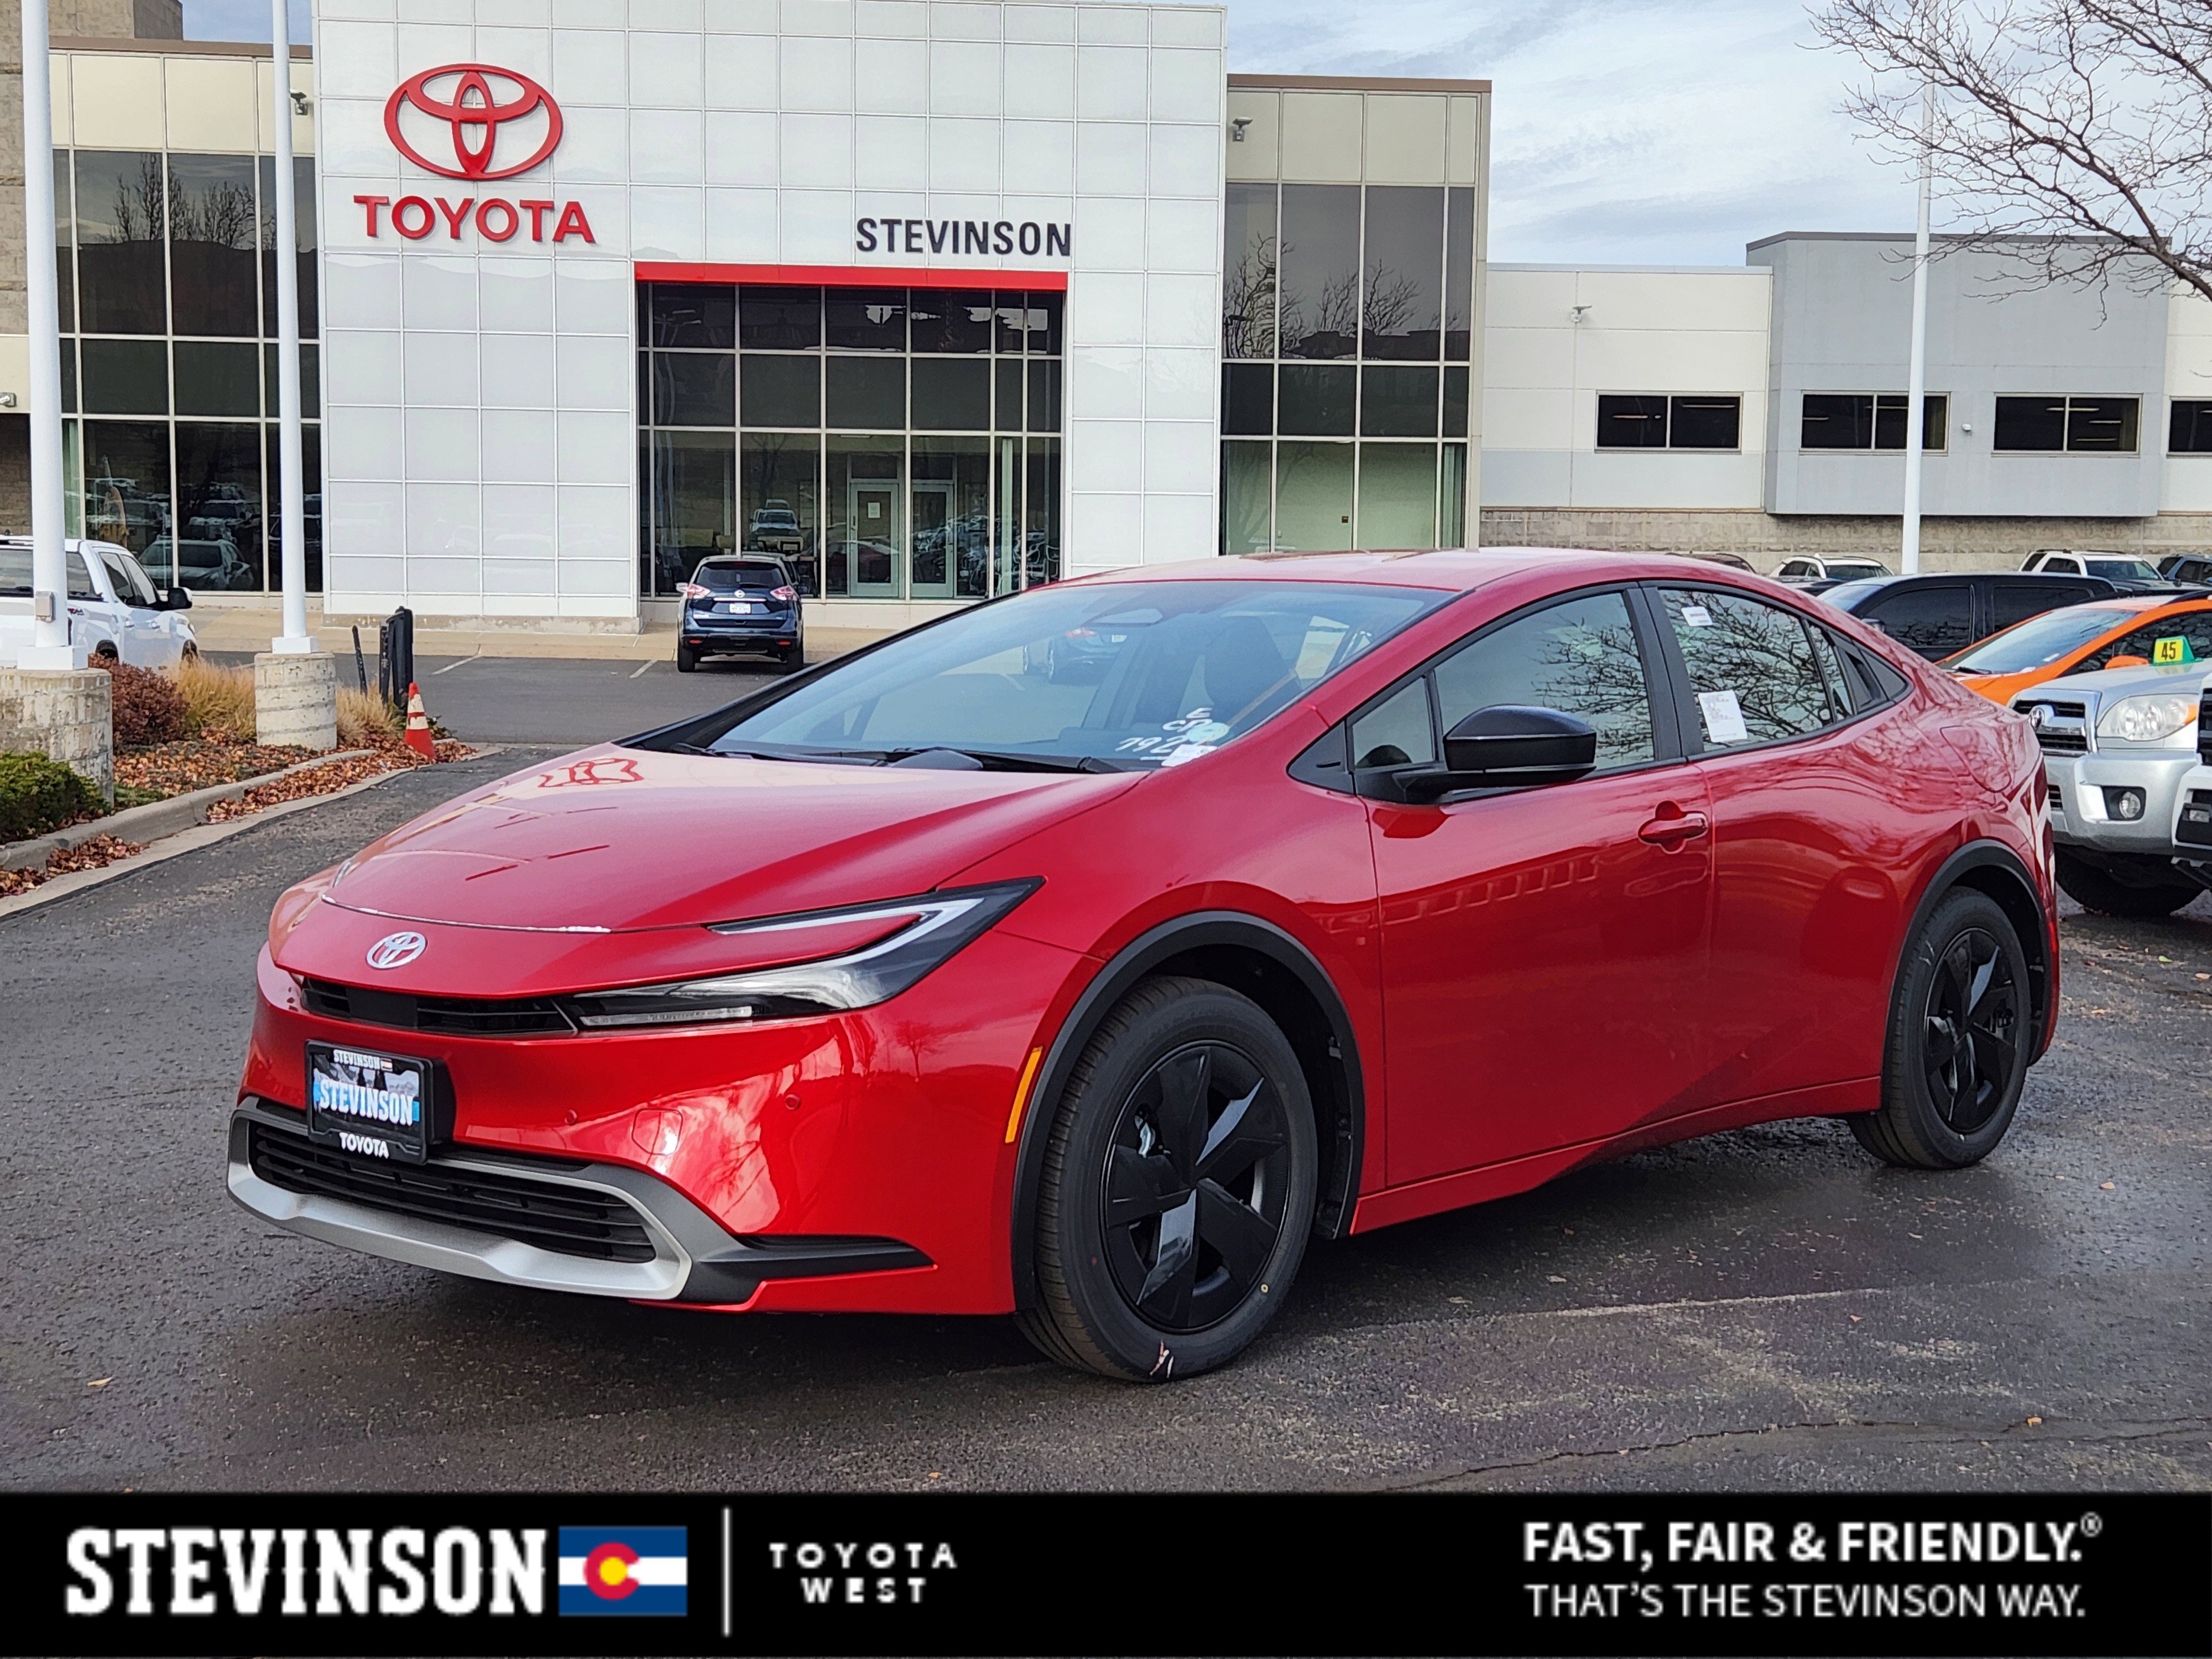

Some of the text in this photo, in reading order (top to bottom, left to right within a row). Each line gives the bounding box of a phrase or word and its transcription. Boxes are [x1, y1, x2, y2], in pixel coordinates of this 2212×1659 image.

[353, 195, 596, 244] TOYOTA
[855, 217, 1071, 256] STEVINSON
[2161, 641, 2177, 661] 45
[333, 1049, 380, 1070] STEVINSON
[319, 1079, 413, 1126] STEVINSON
[339, 1132, 389, 1159] TOYOTA
